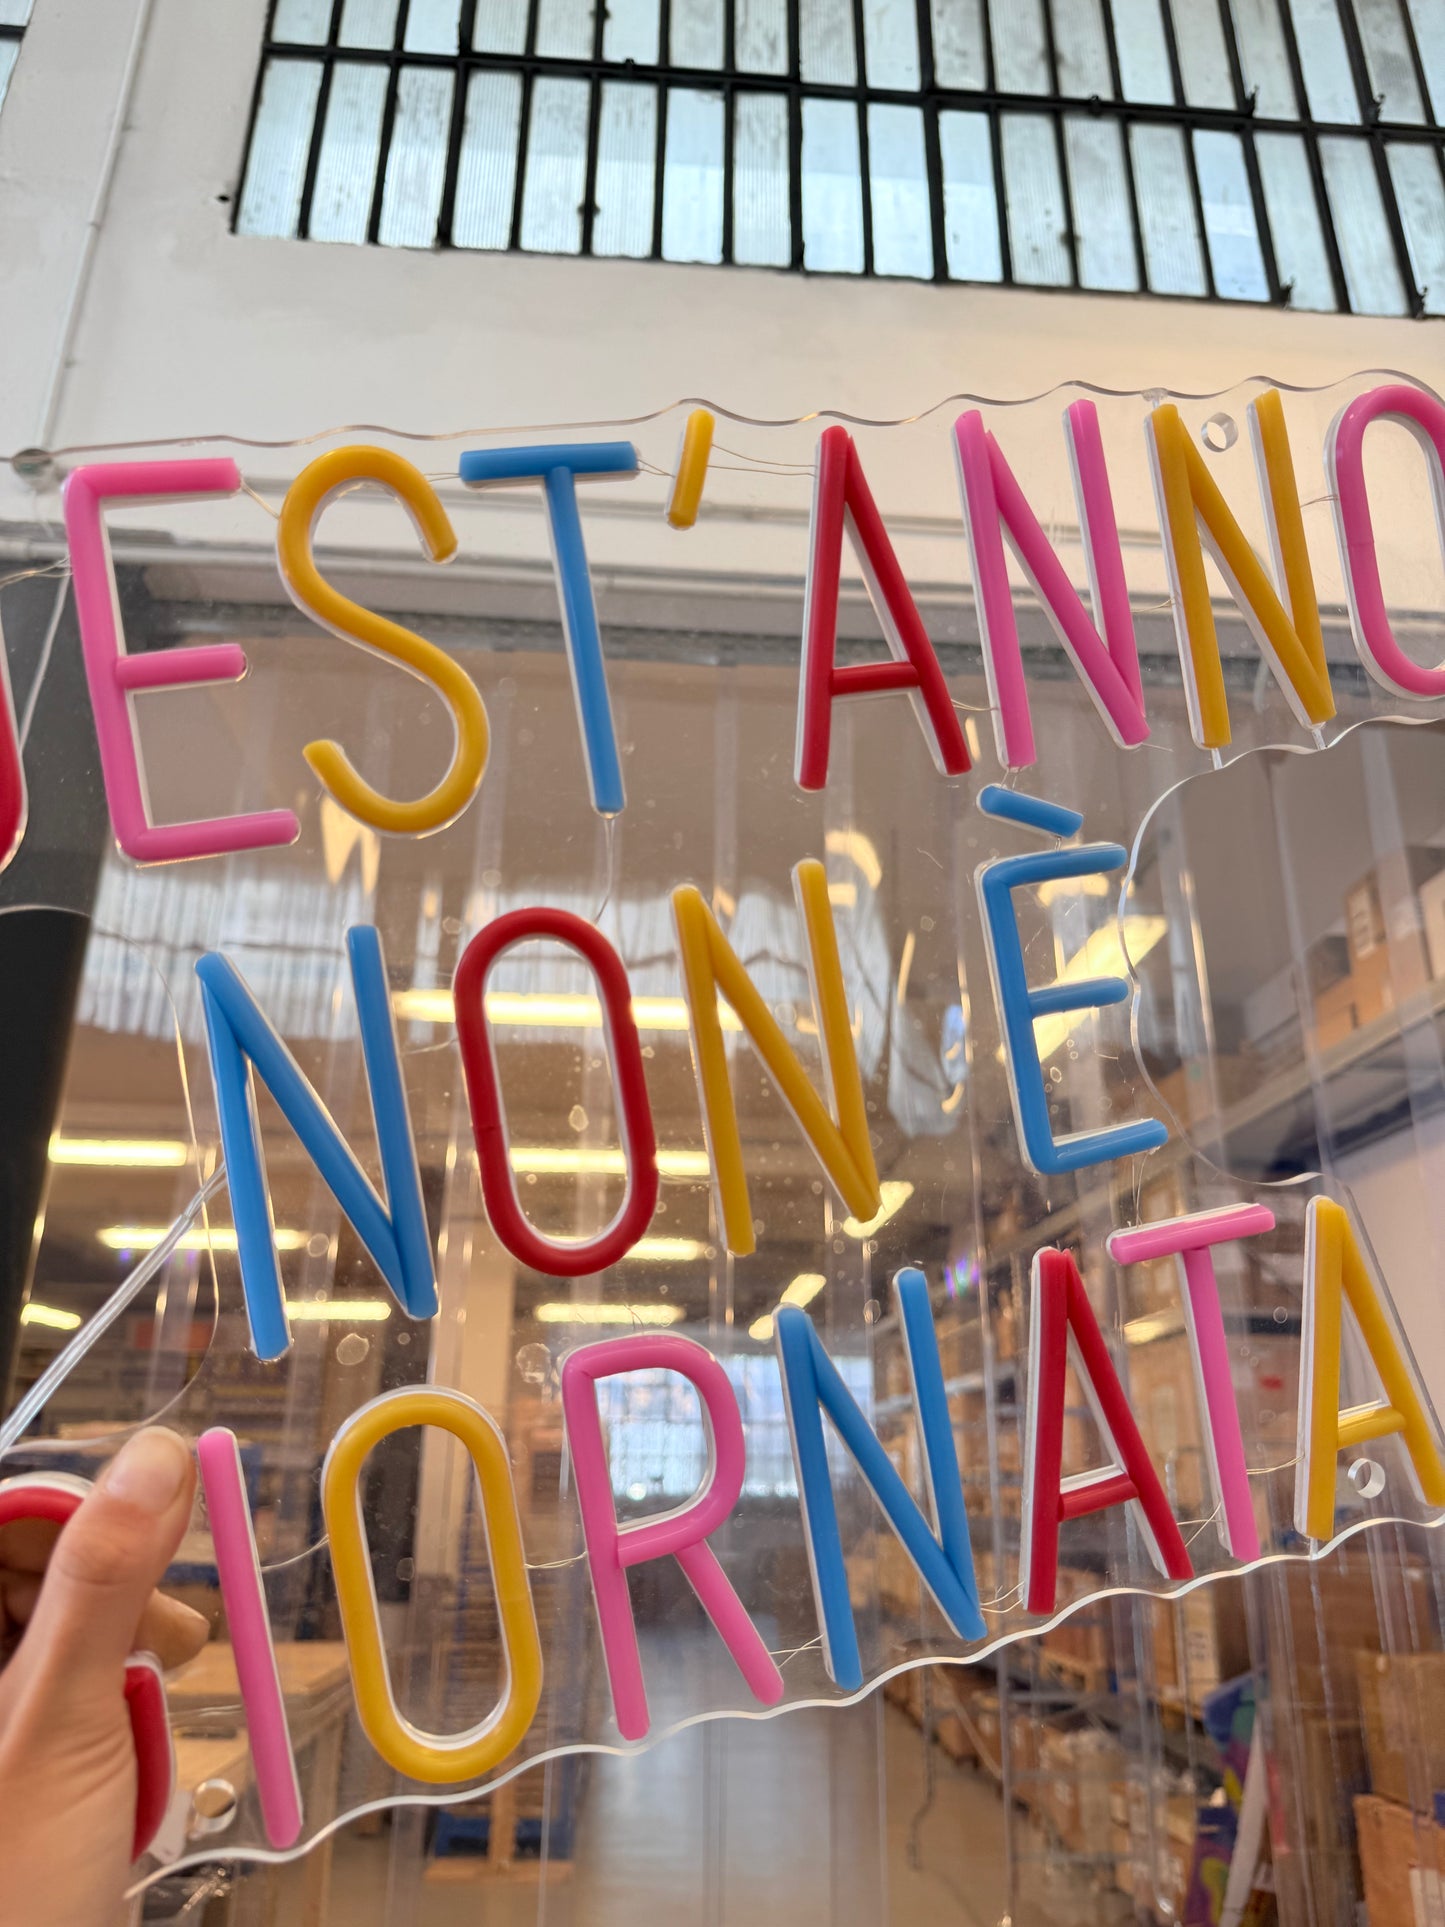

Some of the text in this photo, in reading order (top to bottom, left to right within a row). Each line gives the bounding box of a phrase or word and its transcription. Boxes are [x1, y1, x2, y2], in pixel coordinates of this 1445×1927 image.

[0, 385, 1445, 867] EST'ANNO
[195, 784, 1168, 1358] NON È
